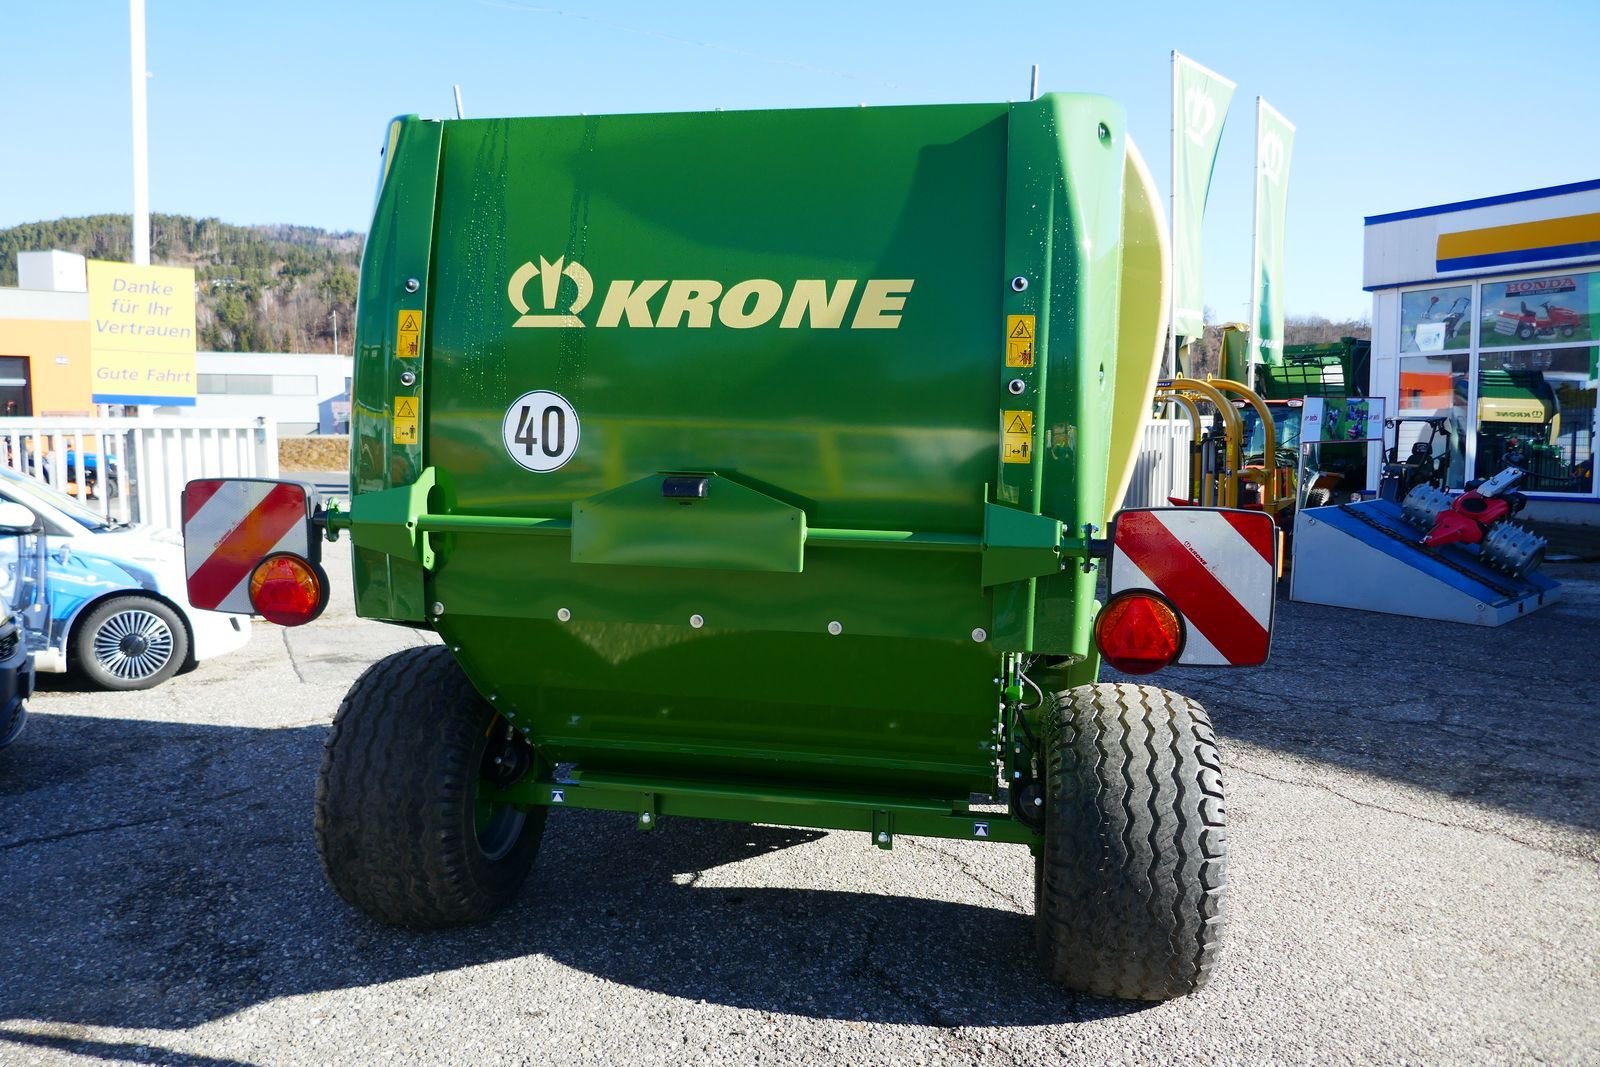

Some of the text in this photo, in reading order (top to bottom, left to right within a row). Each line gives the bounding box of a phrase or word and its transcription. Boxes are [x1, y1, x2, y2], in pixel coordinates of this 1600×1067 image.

[112, 278, 174, 296] Danke
[1506, 277, 1577, 293] HONDA
[111, 298, 173, 316] für Ihr
[595, 278, 916, 329] KRONE
[96, 319, 192, 338] Vertrauen
[96, 367, 192, 383] Gute Fahrt
[514, 405, 566, 458] 40
[1189, 547, 1208, 566] KRONE
